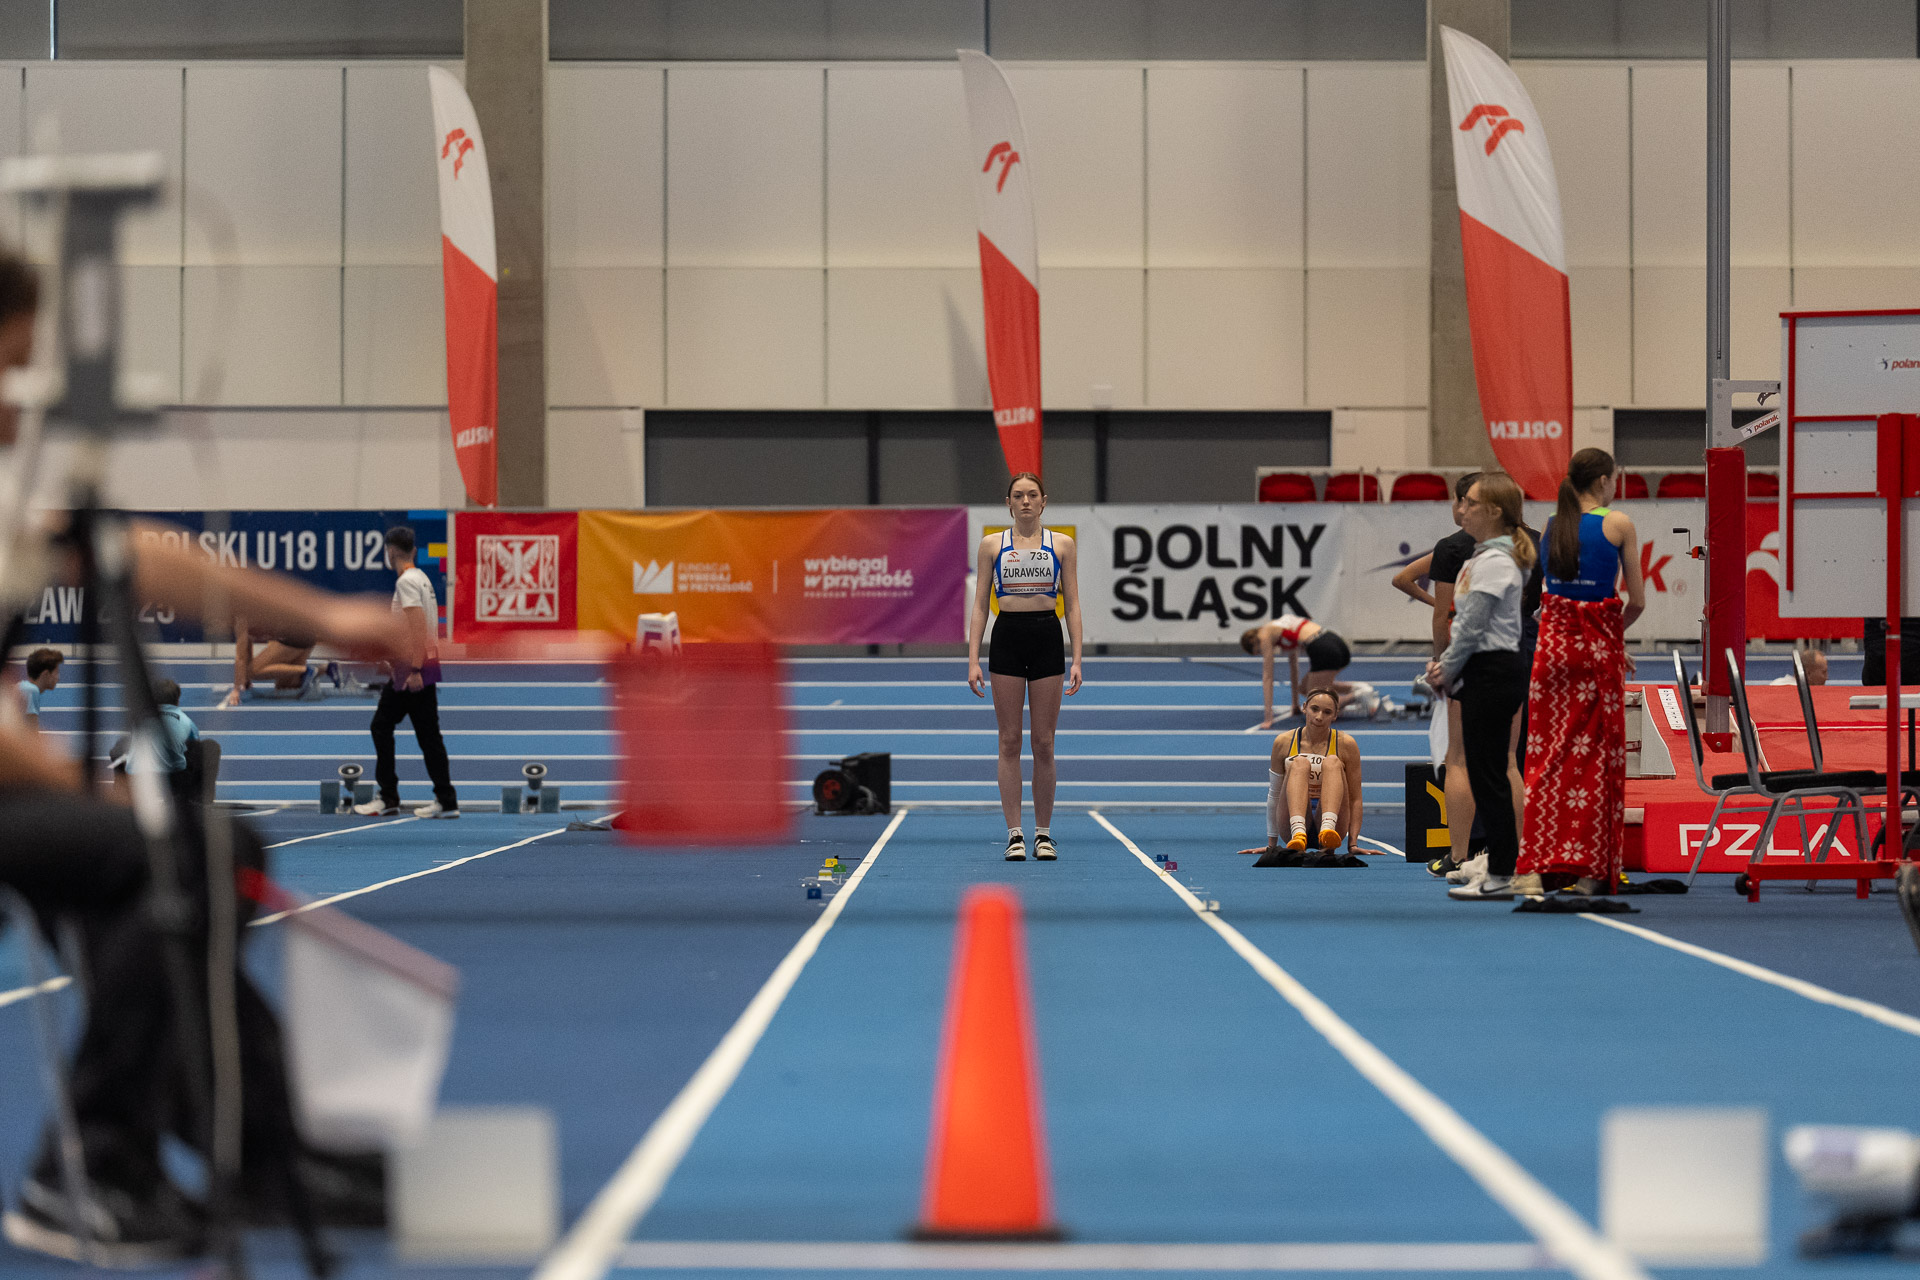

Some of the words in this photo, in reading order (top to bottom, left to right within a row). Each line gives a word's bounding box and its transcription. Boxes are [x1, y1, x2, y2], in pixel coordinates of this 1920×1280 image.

[1754, 415, 1779, 432] polanik
[257, 530, 317, 570] U18
[326, 530, 335, 570] I
[1030, 552, 1049, 560] 733
[1112, 525, 1327, 570] DOLNY
[804, 555, 888, 574] wybiegaj
[1003, 566, 1052, 578] ŻURAWSKA
[804, 574, 821, 587] w
[481, 592, 553, 615] PZLA
[1111, 564, 1312, 628] ŚLĄSK
[1311, 756, 1325, 765] 10
[1679, 824, 1851, 857] PZLA
